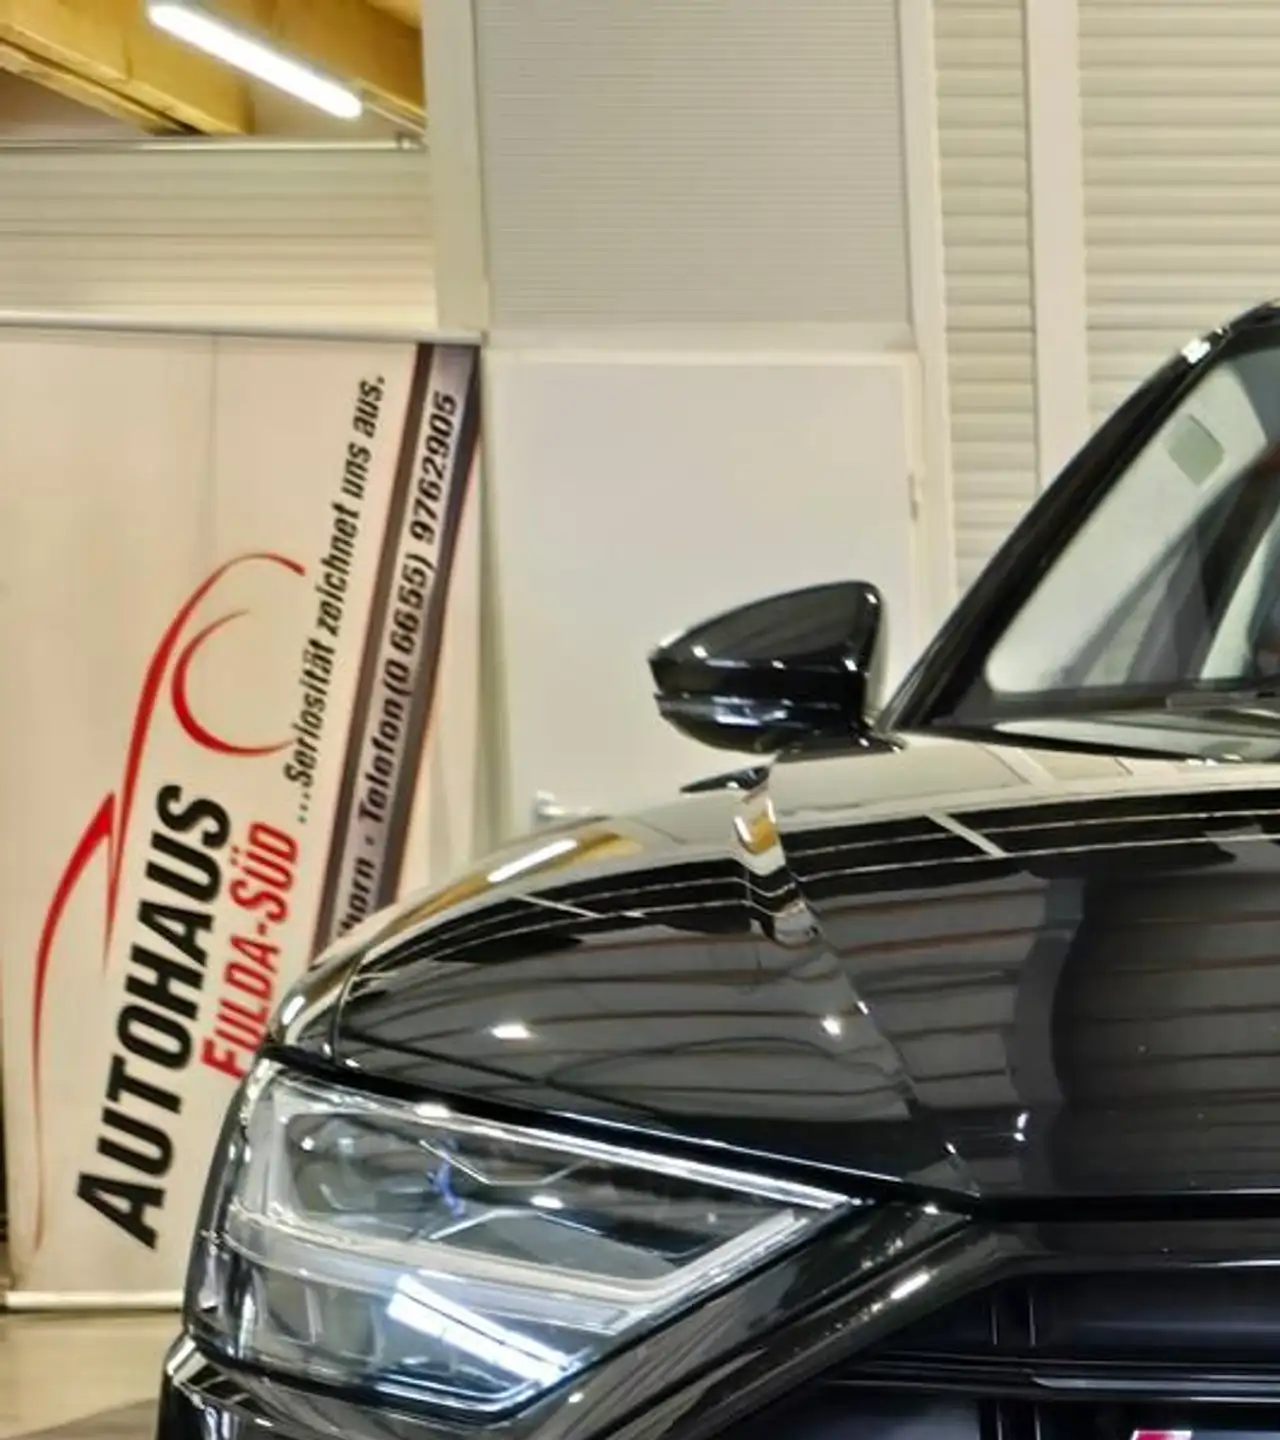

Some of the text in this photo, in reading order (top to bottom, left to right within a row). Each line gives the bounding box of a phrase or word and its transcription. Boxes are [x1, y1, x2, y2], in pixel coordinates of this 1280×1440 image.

[340, 442, 372, 500] uns
[352, 375, 386, 438] aus.
[408, 389, 458, 546] 9762905
[314, 501, 360, 638] zeichnet
[76, 784, 231, 1250] AUTOHAUS
[200, 820, 299, 1080] FULDA-SÜD
